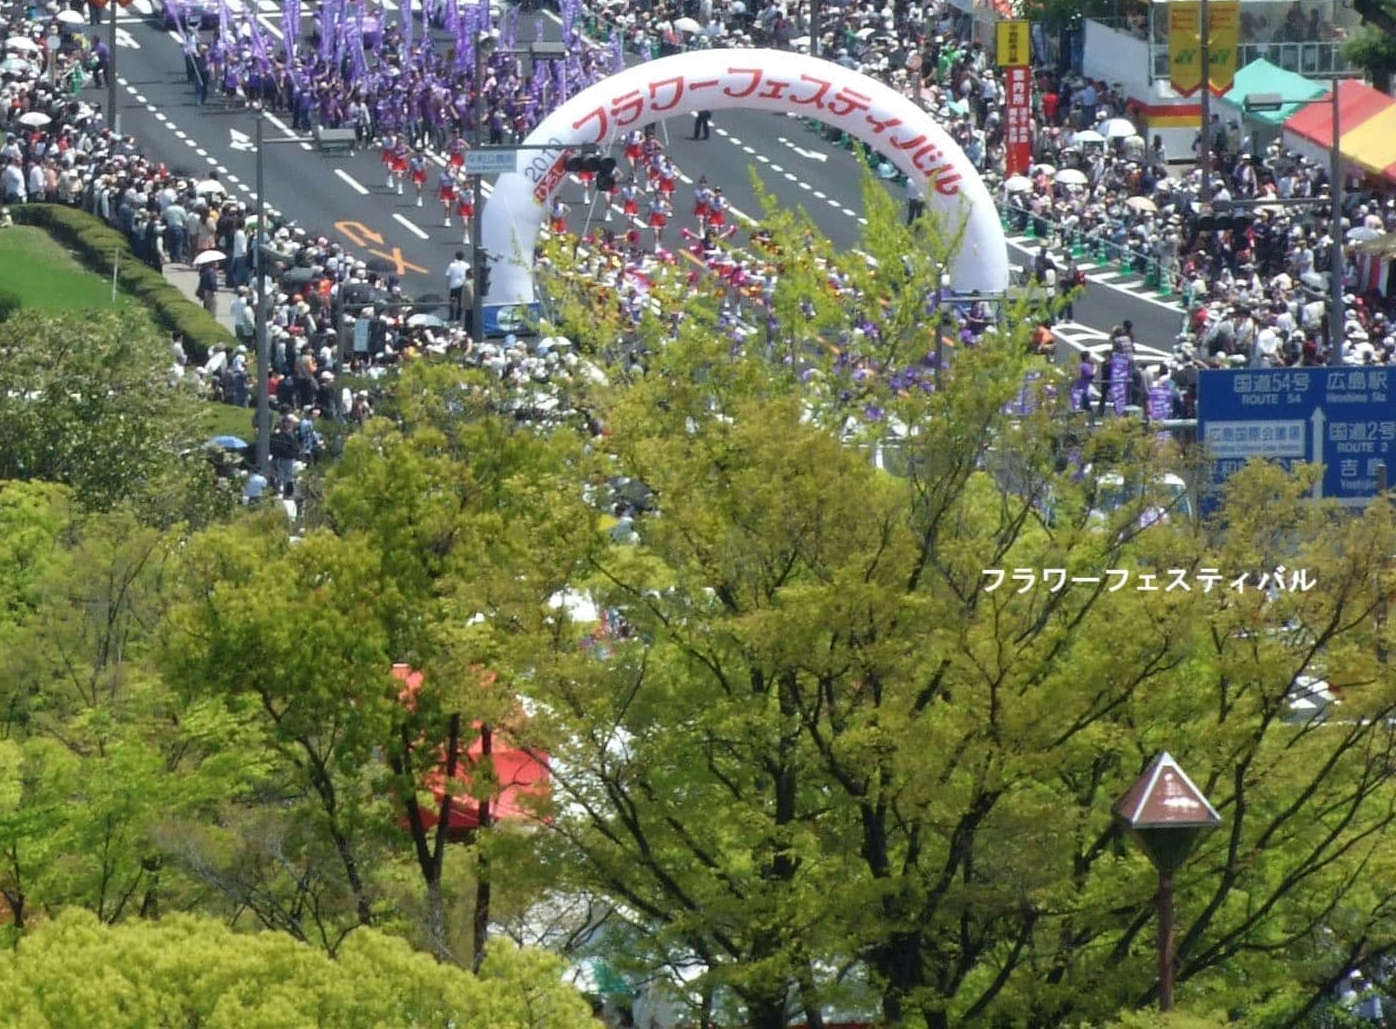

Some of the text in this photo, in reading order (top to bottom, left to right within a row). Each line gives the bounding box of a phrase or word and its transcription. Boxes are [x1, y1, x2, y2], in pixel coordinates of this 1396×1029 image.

[572, 66, 961, 197] フラワーフェスティバル
[1233, 372, 1311, 393] 国道54号
[1326, 371, 1389, 391] 広島駅
[1242, 393, 1303, 405] ROUTE 54
[1329, 422, 1396, 441] 国道2号
[1337, 442, 1389, 453] ROUTE 2
